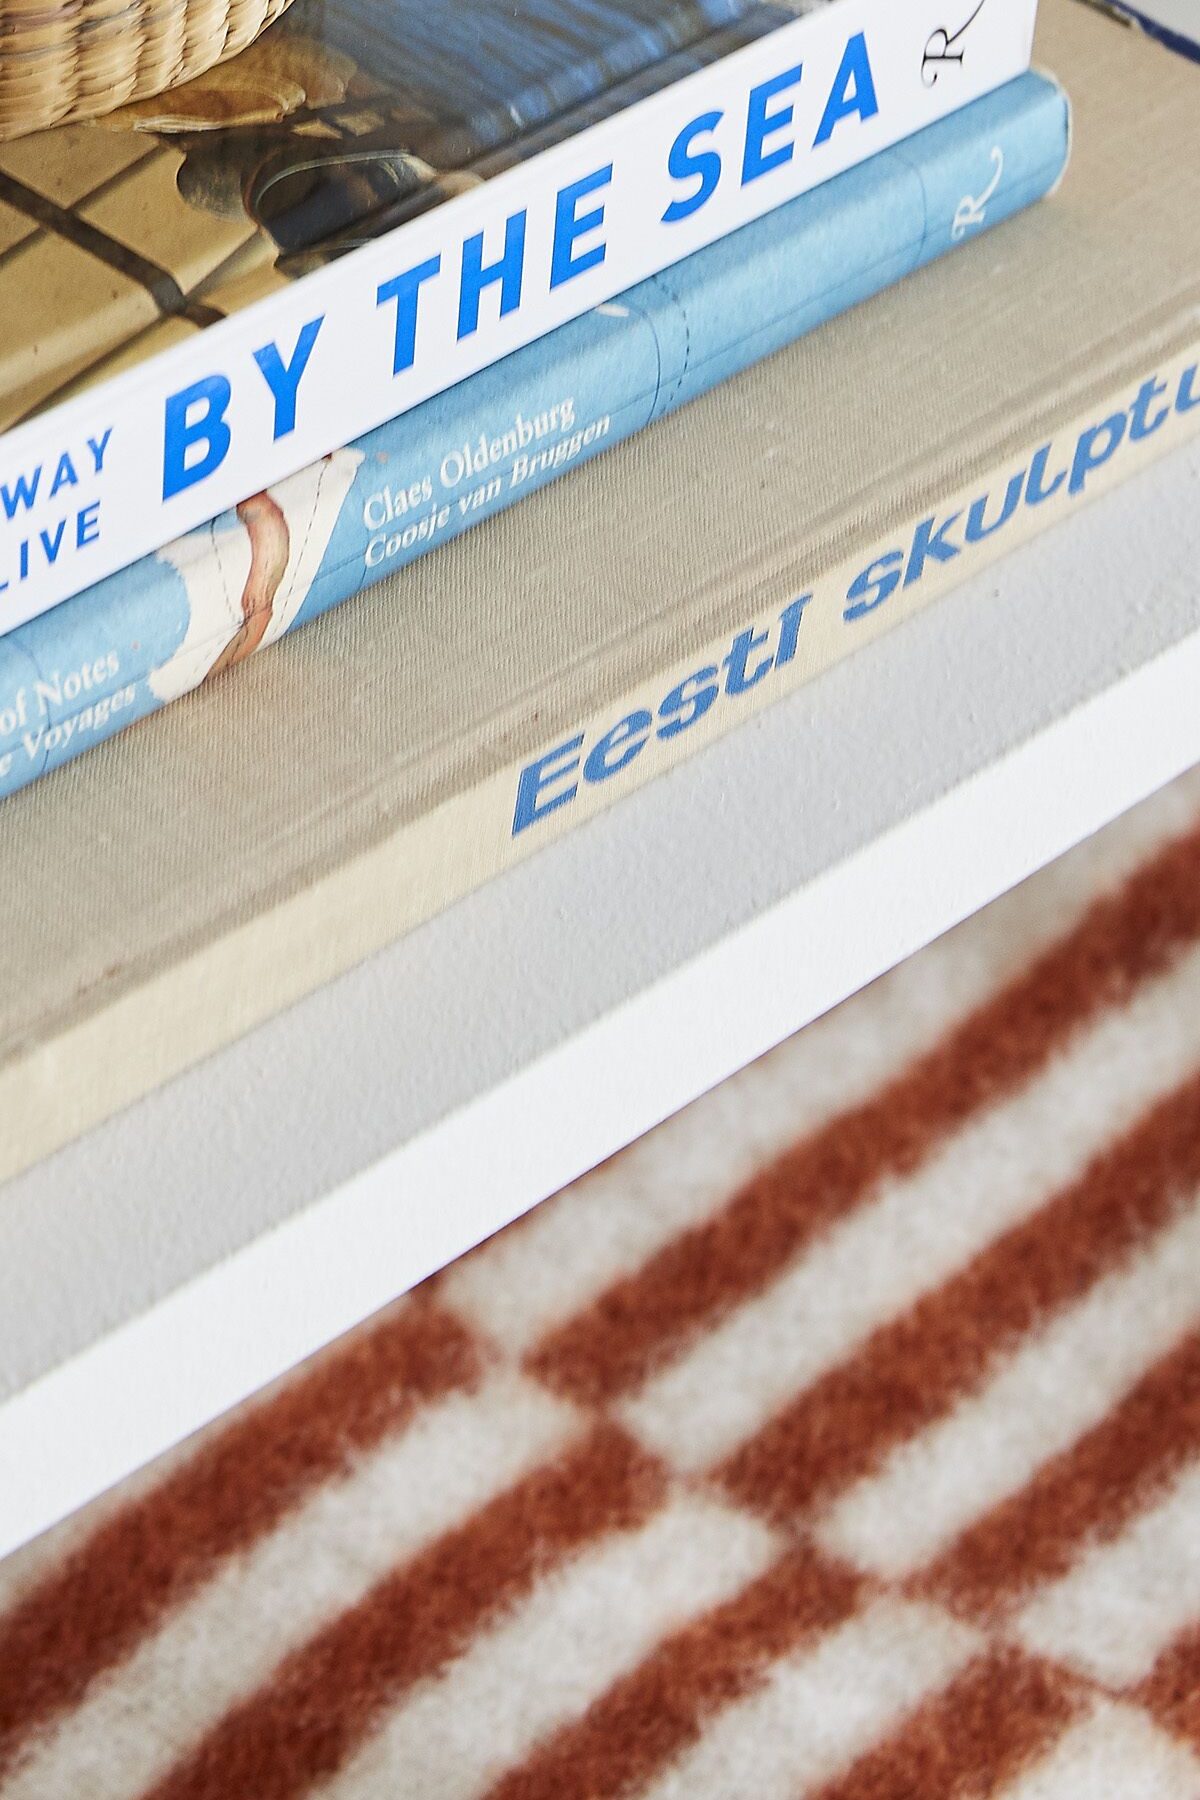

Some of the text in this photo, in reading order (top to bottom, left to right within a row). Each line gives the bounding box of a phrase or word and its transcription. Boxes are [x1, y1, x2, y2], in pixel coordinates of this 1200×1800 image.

[164, 31, 879, 502] BY THE SEA
[0, 427, 114, 524] WAY
[363, 396, 575, 531] Claes Oldenburg
[364, 415, 612, 568] Coosje van Bruggen
[23, 682, 137, 760] Voyages
[33, 650, 120, 716] Notes
